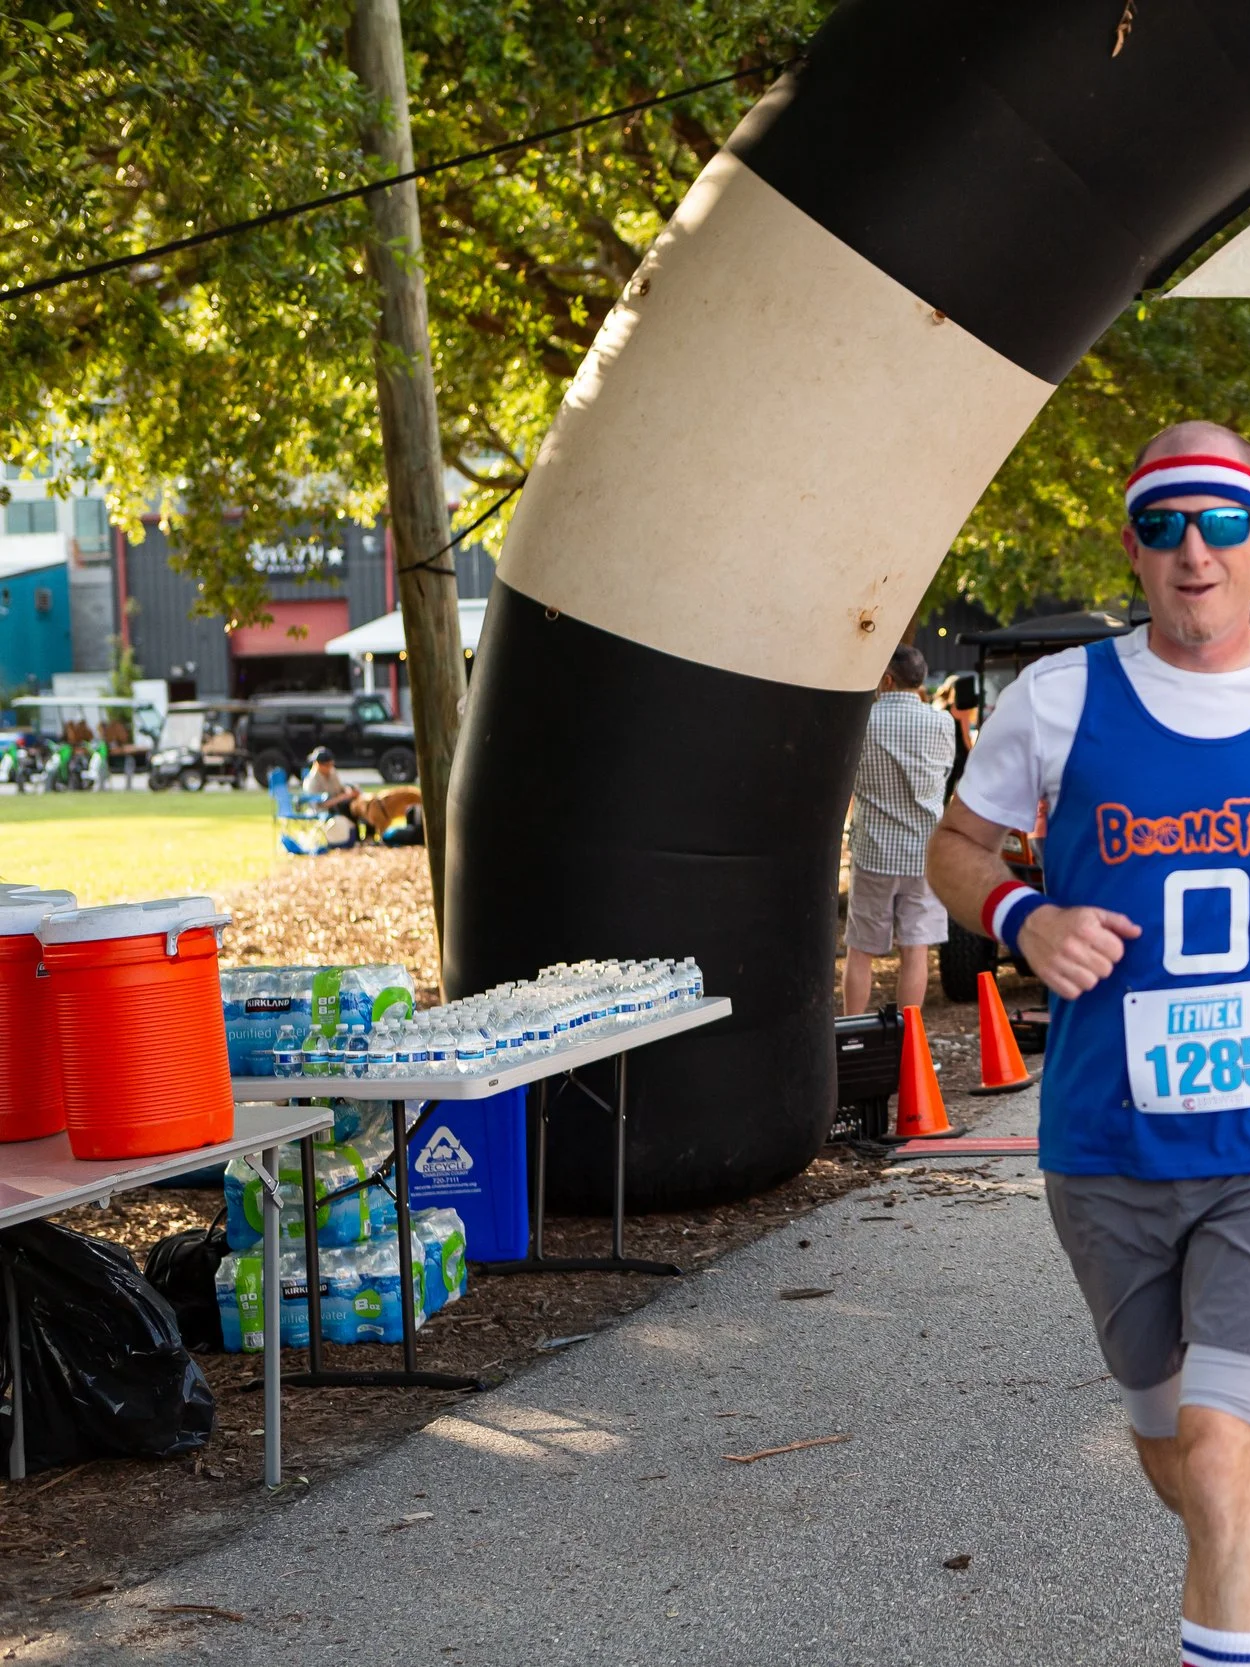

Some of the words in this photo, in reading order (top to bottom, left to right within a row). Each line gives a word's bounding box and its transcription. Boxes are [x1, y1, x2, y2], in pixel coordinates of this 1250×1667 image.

[1163, 868, 1250, 976] 0
[246, 997, 290, 1008] KIRKLAND
[228, 1027, 272, 1041] purified
[422, 1161, 467, 1173] RECYCLE
[284, 1284, 328, 1295] KIRKD
